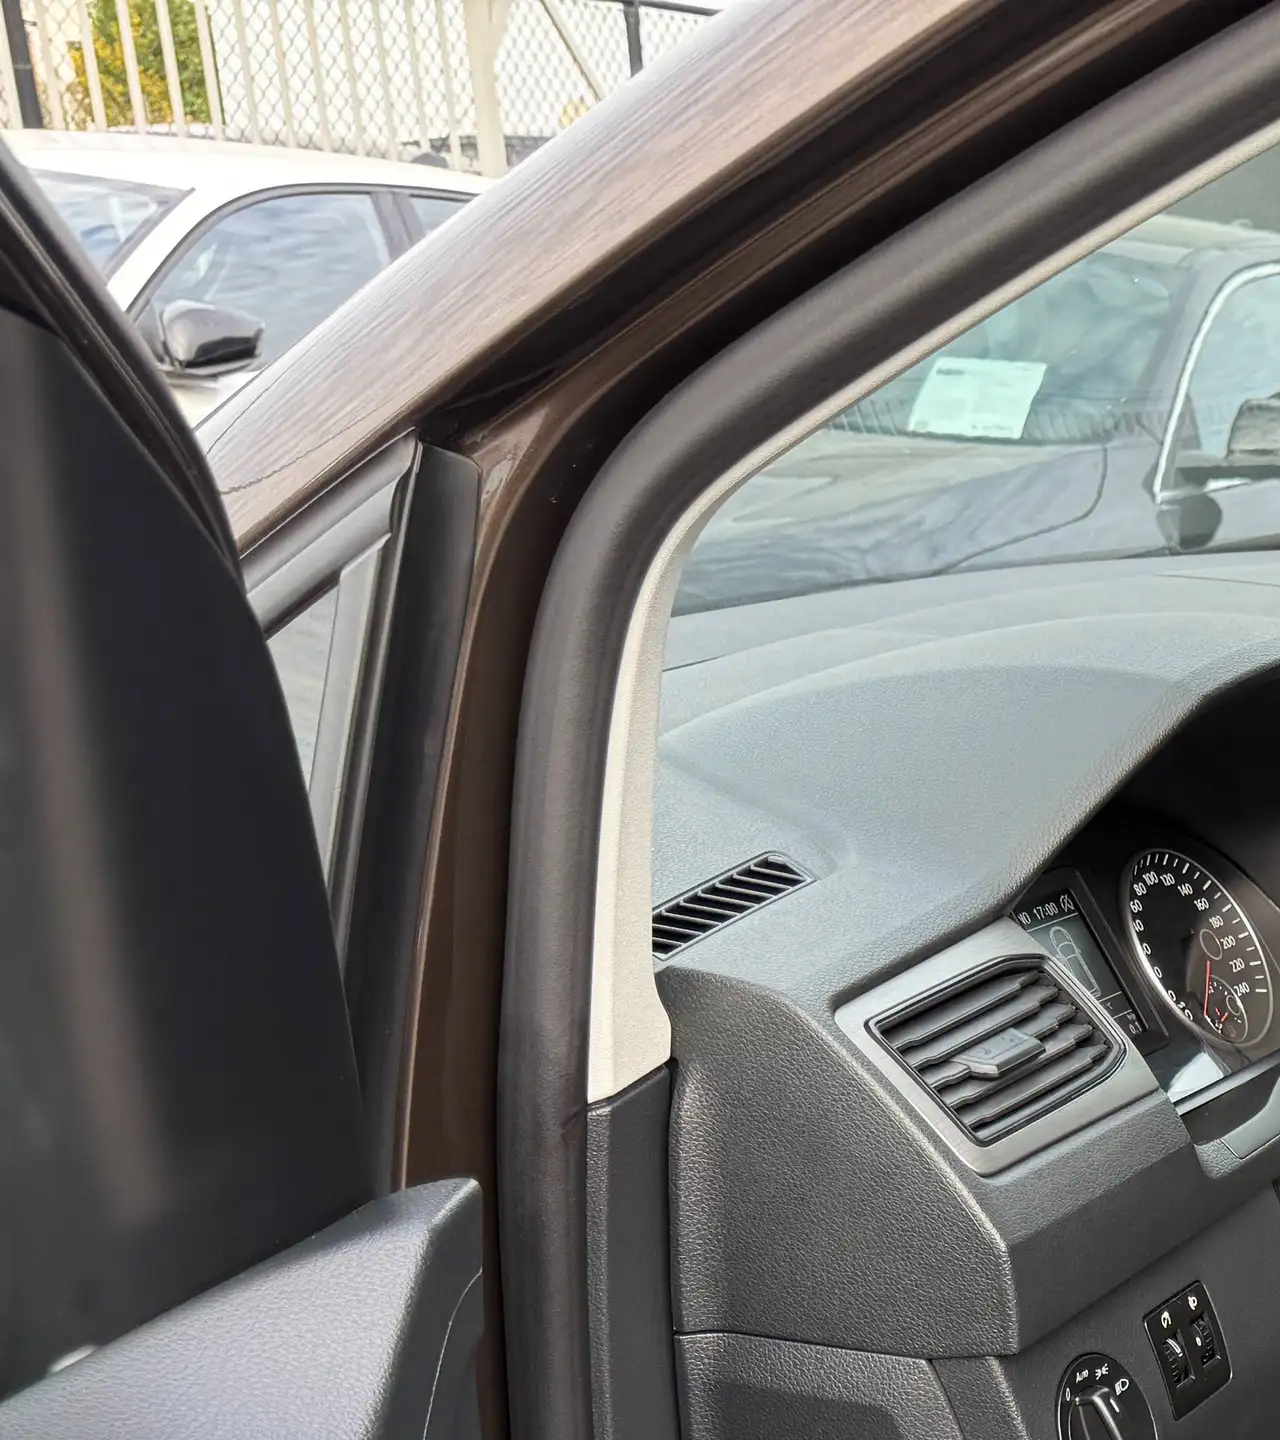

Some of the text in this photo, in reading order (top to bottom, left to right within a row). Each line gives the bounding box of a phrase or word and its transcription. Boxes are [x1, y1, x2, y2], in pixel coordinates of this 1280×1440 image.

[1143, 871, 1158, 886] 100
[1160, 873, 1175, 886] 120
[1133, 882, 1147, 896] 80
[1177, 883, 1193, 896] 140
[1034, 902, 1058, 919] 17:00
[1130, 899, 1143, 913] 60
[1194, 898, 1209, 911] 160
[1209, 915, 1223, 928] 180
[1220, 935, 1236, 950] 200
[1229, 958, 1245, 972] 220
[1234, 981, 1250, 997] 240
